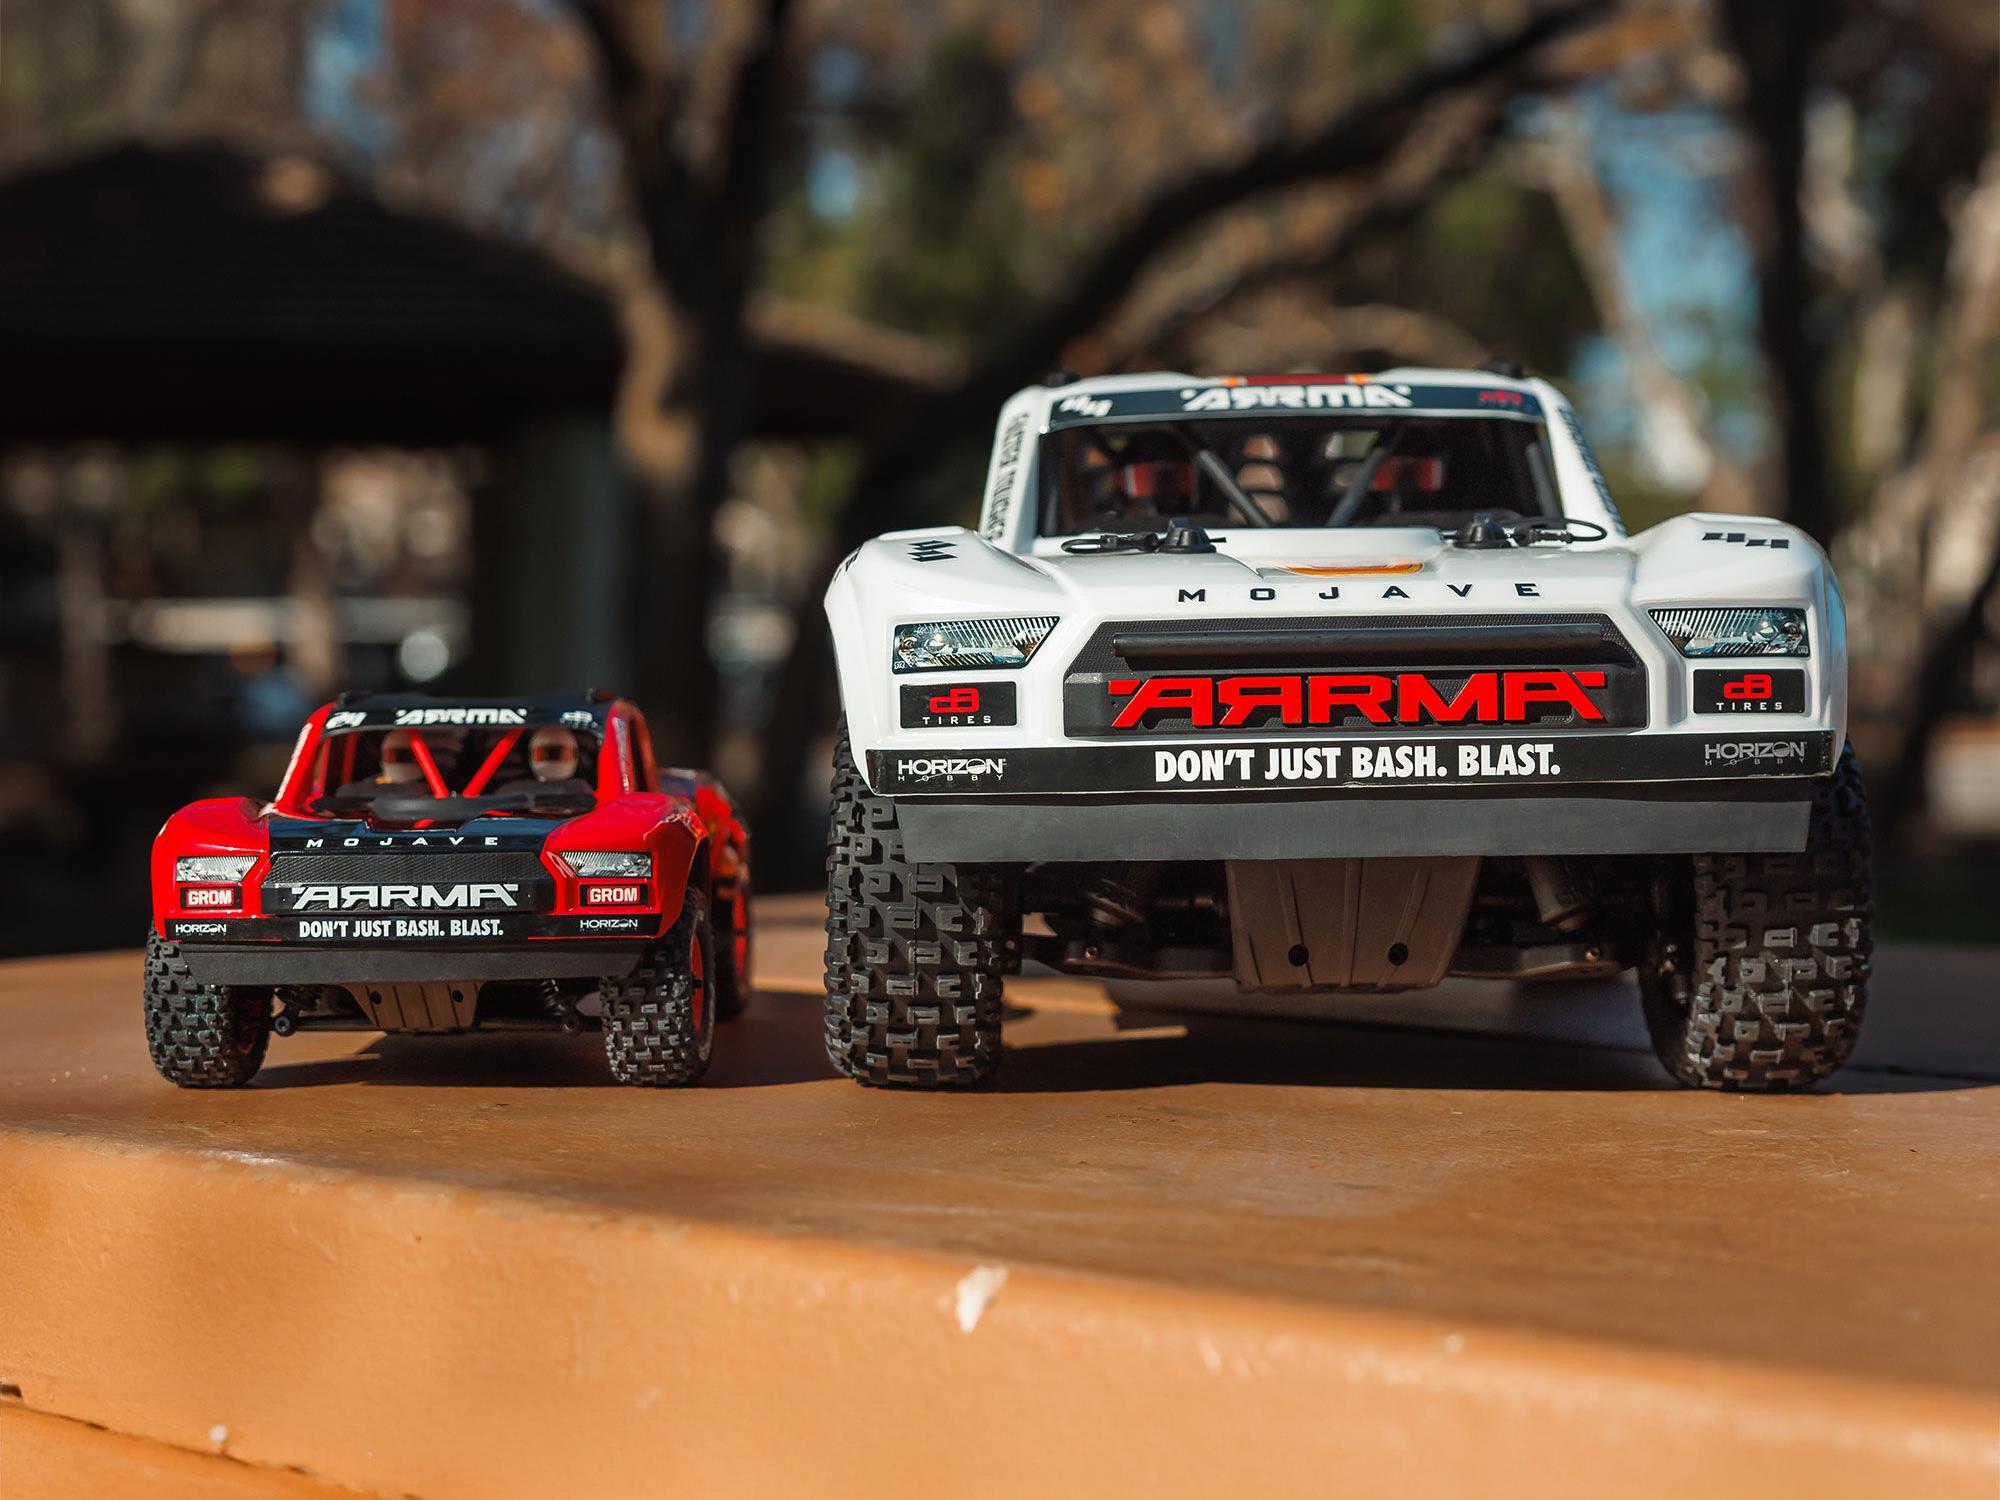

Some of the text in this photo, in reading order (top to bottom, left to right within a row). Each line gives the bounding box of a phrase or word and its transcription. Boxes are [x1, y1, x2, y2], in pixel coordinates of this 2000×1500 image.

[1178, 583, 1540, 602] MOJAVE
[1724, 674, 1772, 699] dB
[930, 688, 979, 713] dB
[1109, 672, 1604, 728] ARRMA
[1716, 702, 1782, 711] TIRES
[922, 715, 991, 725] TIRES
[1705, 742, 1805, 759] HORIZON
[1155, 743, 1561, 782] DON'T JUST BASH. BLAST.
[306, 837, 498, 848] MOJAVE
[188, 890, 232, 906] GROM
[291, 884, 519, 909] ARRMA
[589, 887, 638, 903] GROM
[175, 923, 227, 933] HORIZON
[300, 919, 504, 938] DON'T JUST BASH. BLAST.
[580, 919, 638, 928] HORIZON
